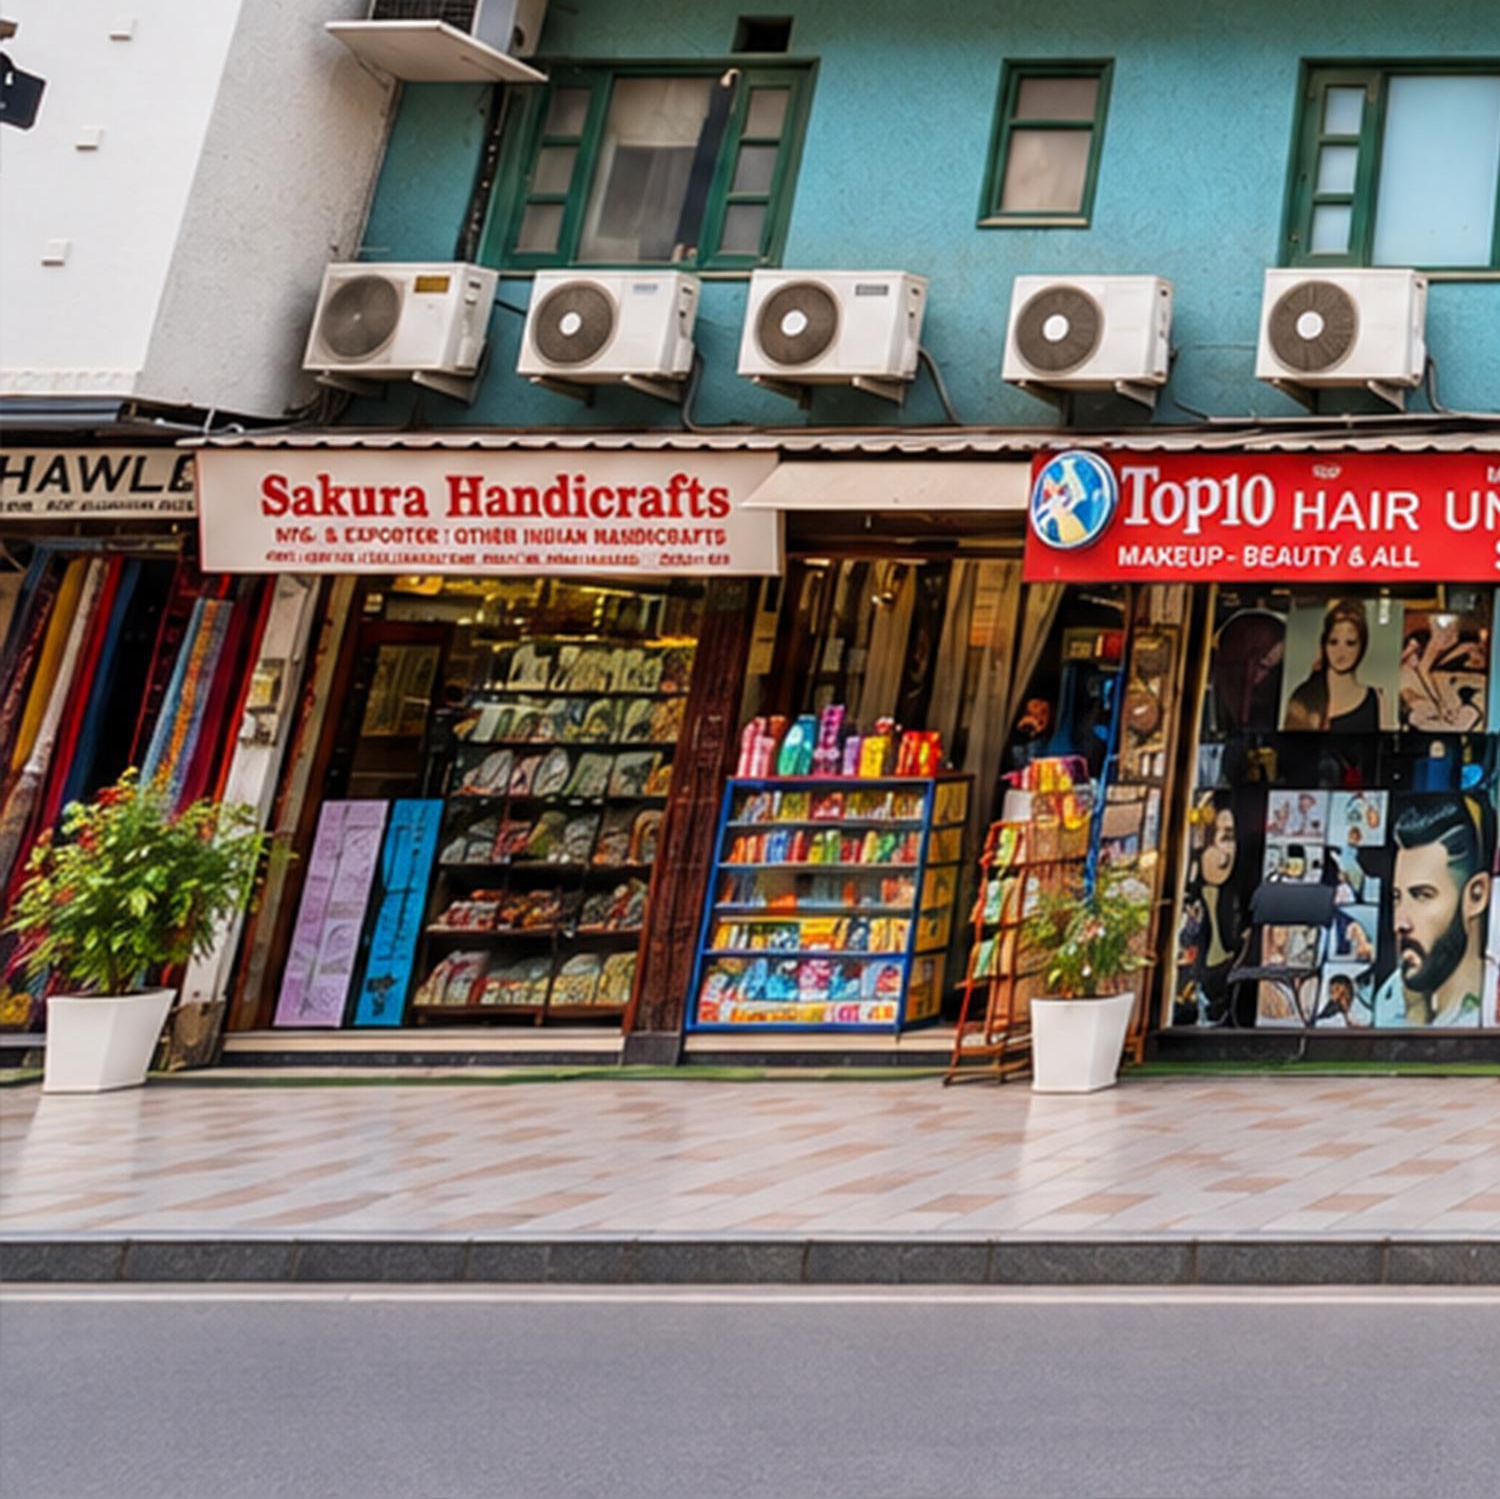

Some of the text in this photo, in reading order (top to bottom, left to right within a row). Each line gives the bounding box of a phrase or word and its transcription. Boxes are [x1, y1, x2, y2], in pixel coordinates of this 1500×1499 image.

[261, 473, 731, 519] Sakura Handicrafts
[1121, 465, 1275, 534] Top10
[1292, 491, 1420, 531] HAIR
[1243, 546, 1342, 567] BEAUTY
[1371, 546, 1420, 567] ALL
